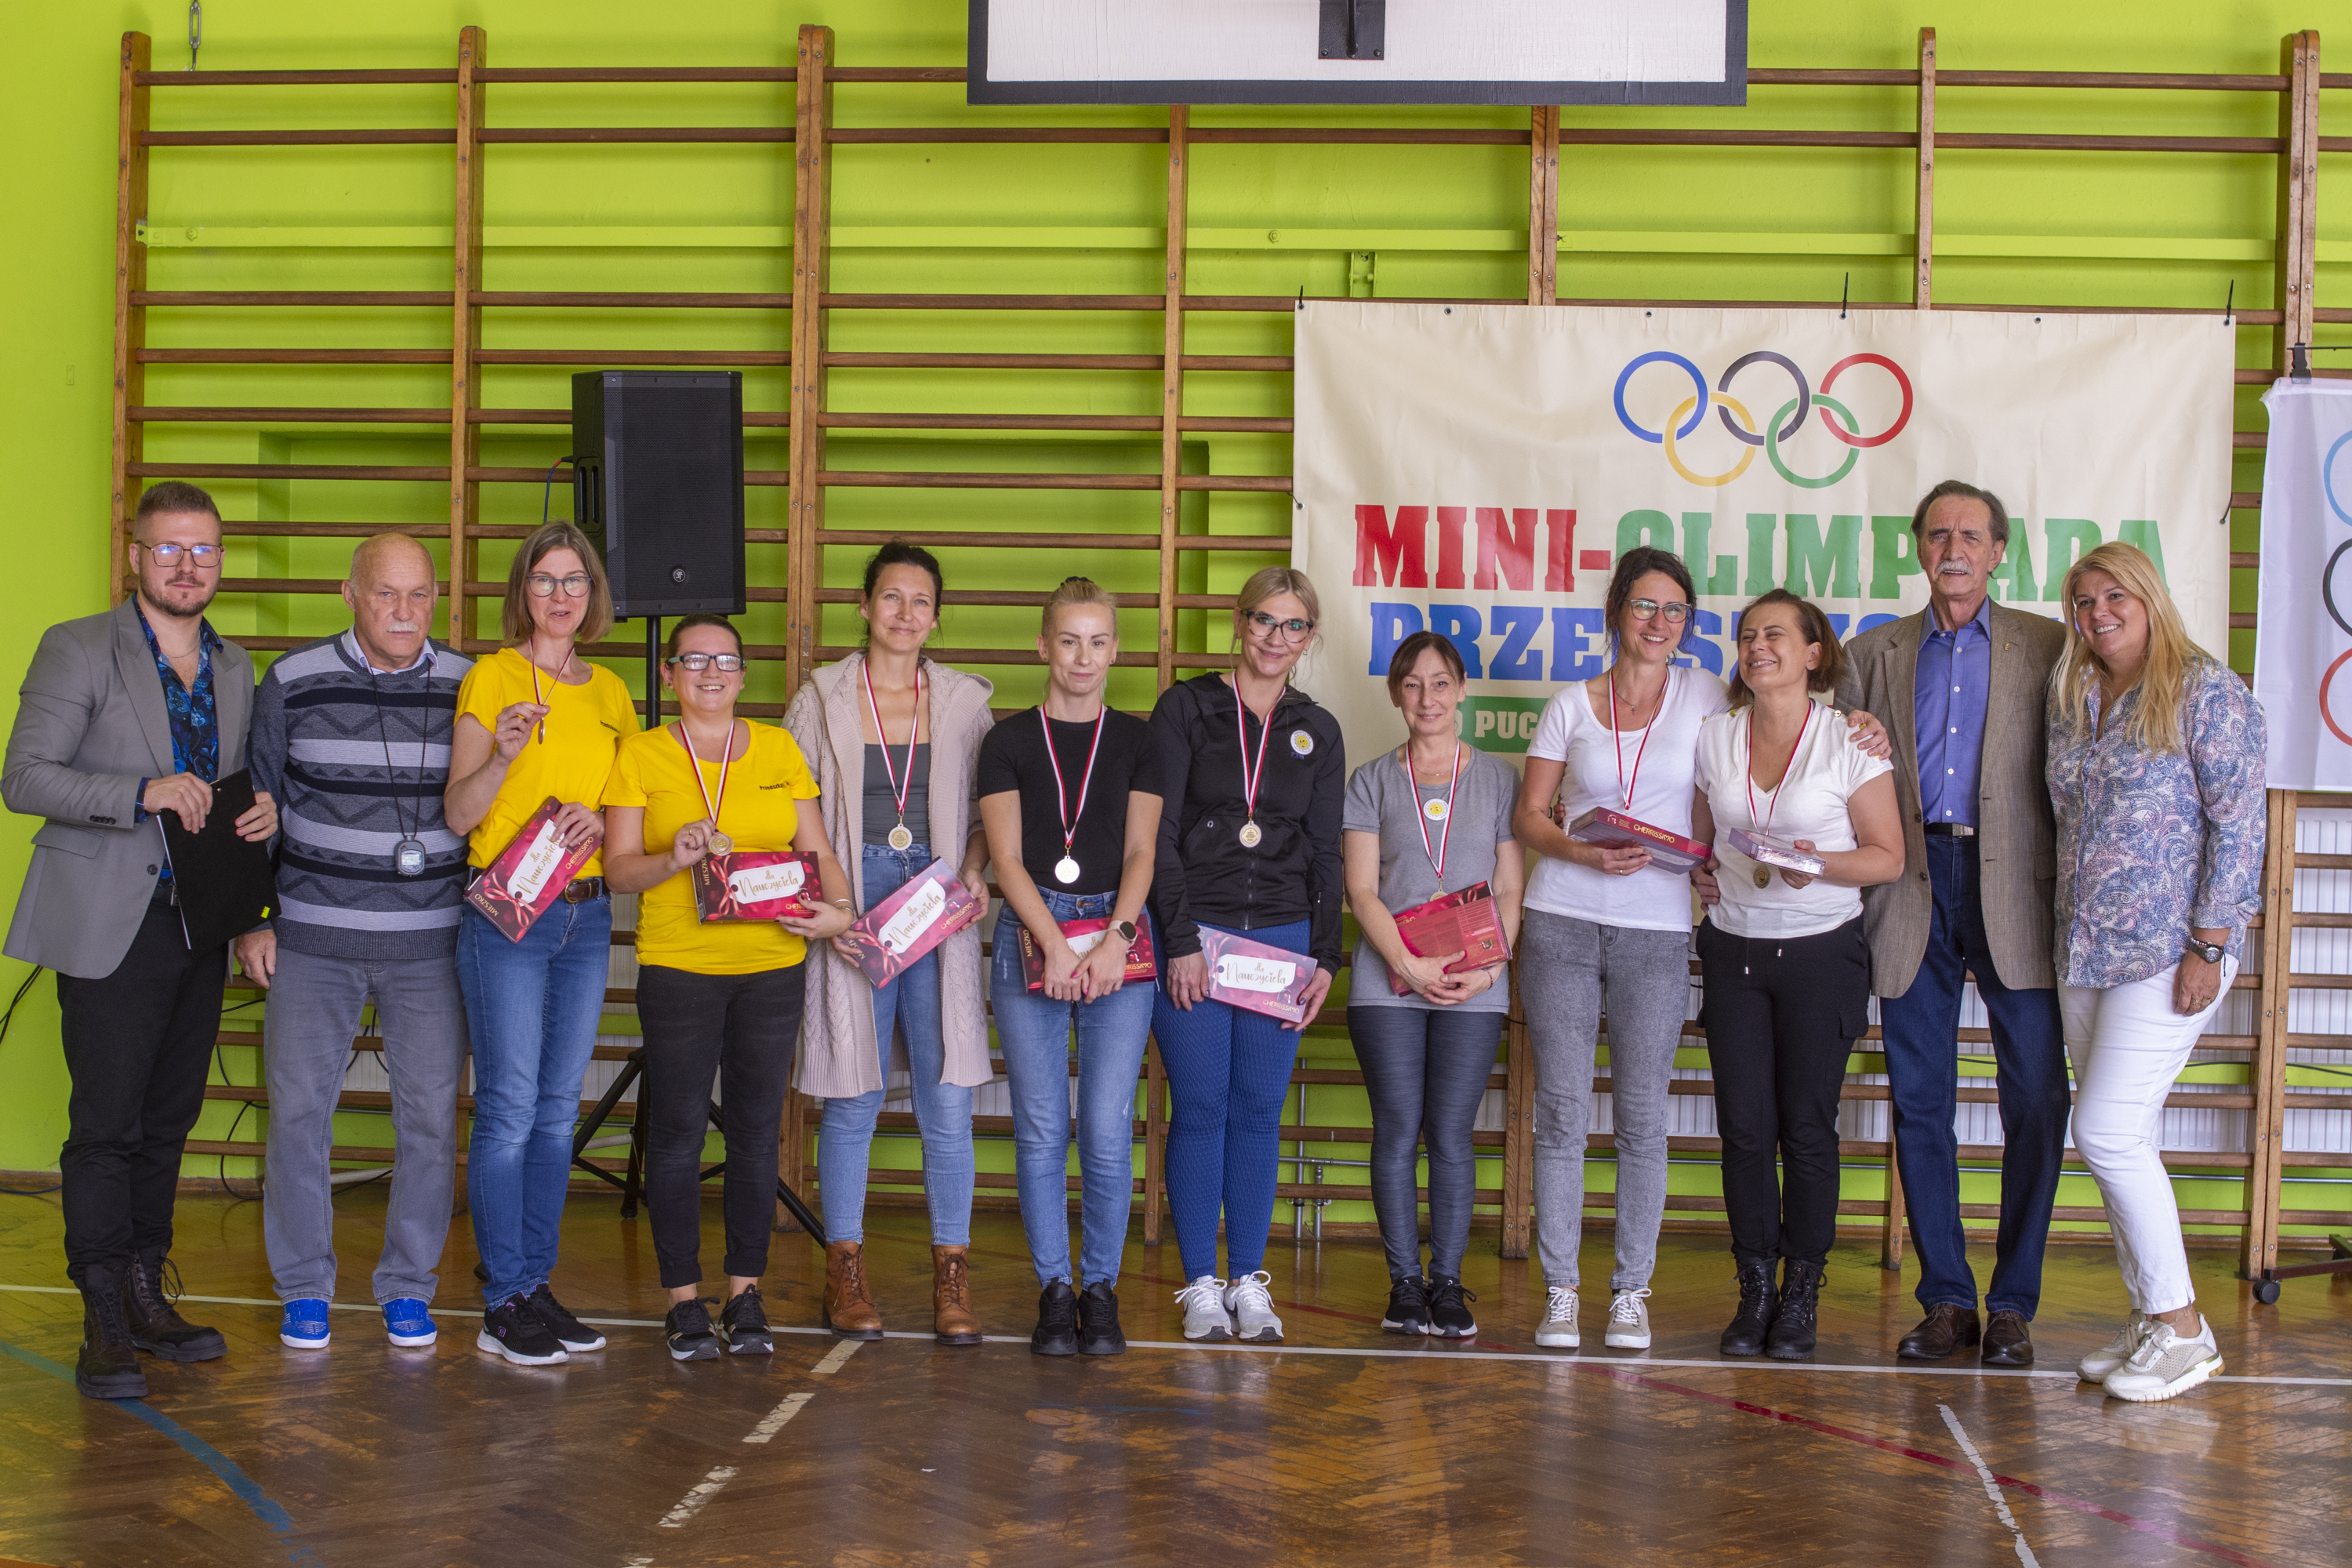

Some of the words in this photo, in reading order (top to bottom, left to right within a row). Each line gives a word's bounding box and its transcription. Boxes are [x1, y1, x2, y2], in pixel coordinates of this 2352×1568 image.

[531, 852, 542, 863] dla
[701, 856, 711, 886] MIESZKO
[765, 869, 775, 880] dla
[739, 870, 799, 898] Nauczyciela
[474, 893, 499, 916] MIESZKO
[908, 906, 918, 917] dla
[888, 892, 942, 946] Nauczyciela
[1022, 929, 1033, 957] MIESZKO
[1226, 961, 1287, 985] Nauczyciela
[1254, 962, 1265, 973] dla
